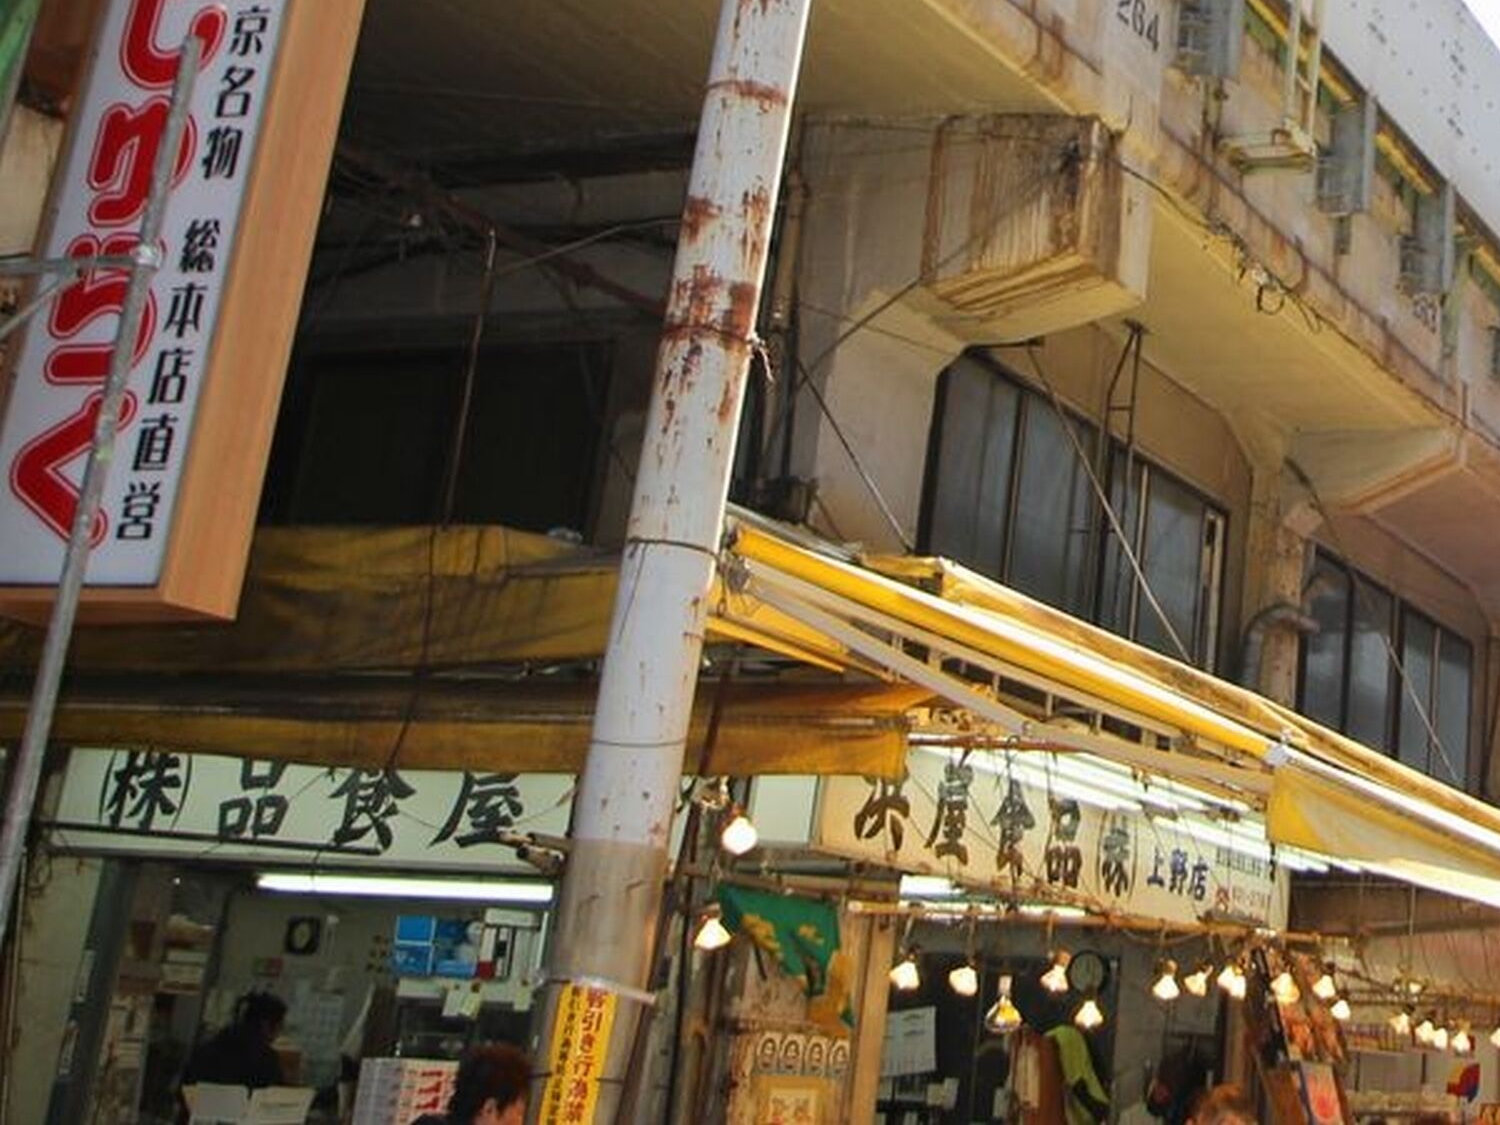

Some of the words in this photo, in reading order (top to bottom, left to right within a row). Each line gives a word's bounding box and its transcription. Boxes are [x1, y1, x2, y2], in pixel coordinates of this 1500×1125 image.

[115, 218, 221, 541] 総本店直営
[1146, 846, 1209, 901] 上野店
